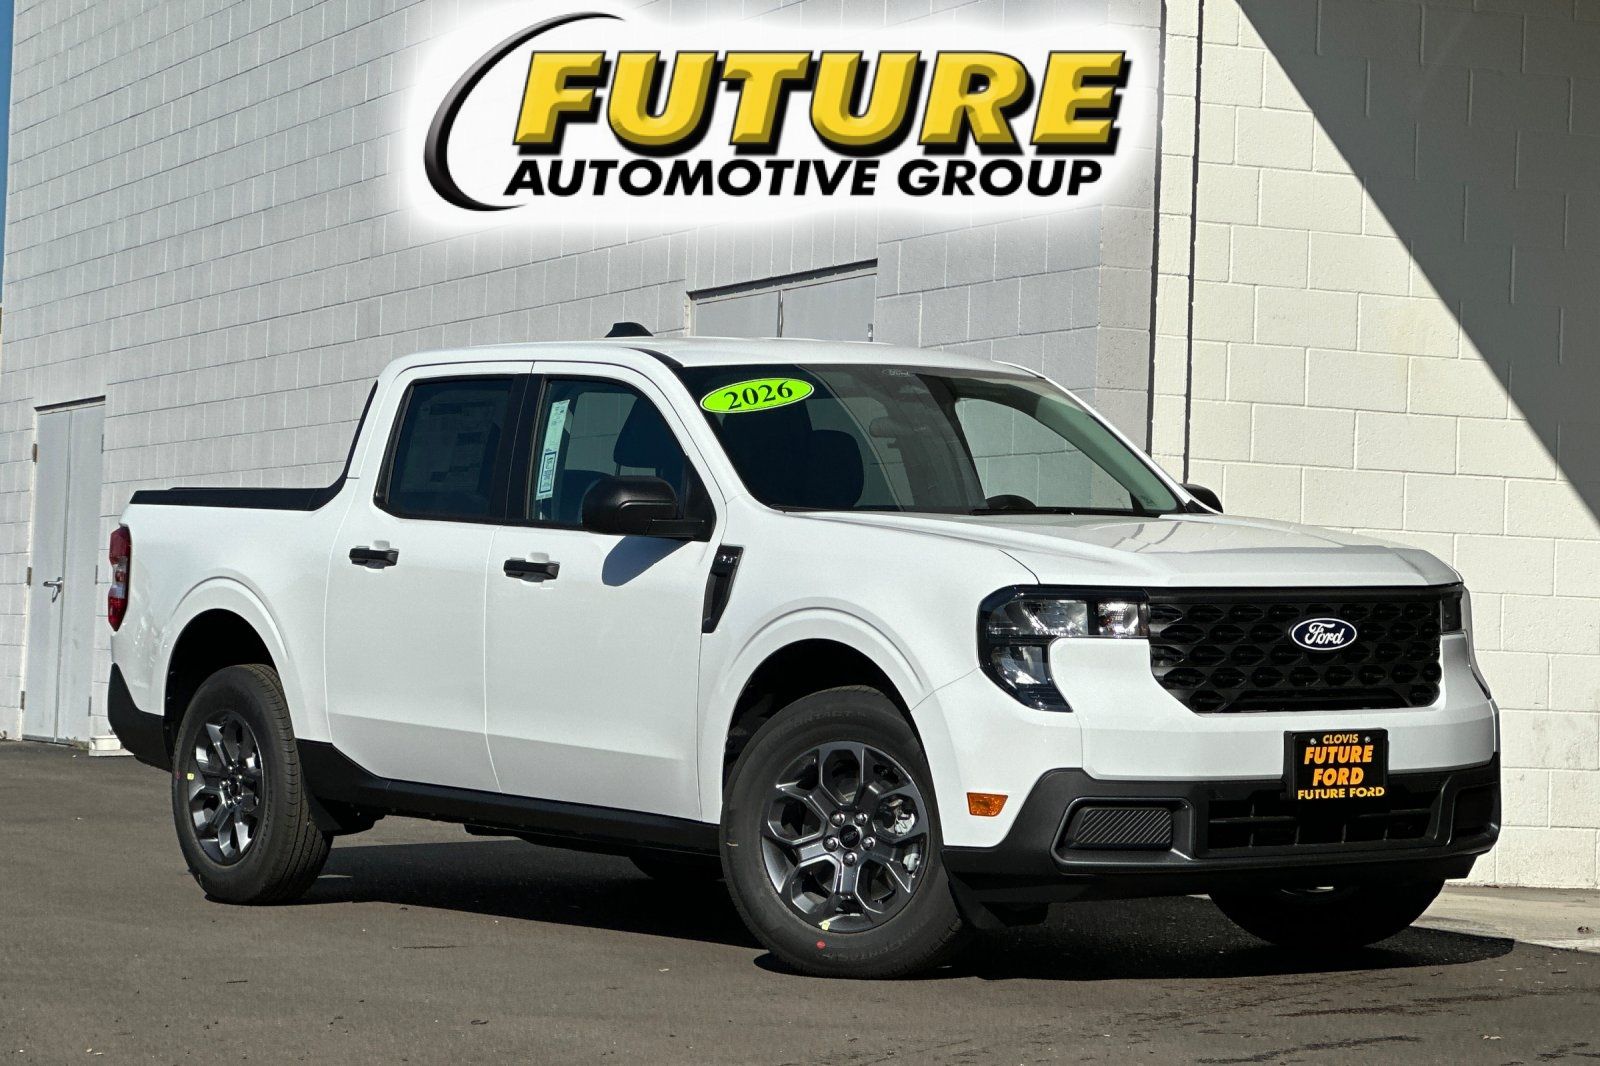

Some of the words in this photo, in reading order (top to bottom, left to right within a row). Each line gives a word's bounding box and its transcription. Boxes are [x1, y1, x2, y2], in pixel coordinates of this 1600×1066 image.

[724, 380, 794, 411] 2026
[1304, 622, 1346, 645] Ford
[1322, 733, 1359, 745] CLOVIS
[1303, 744, 1374, 765] FUTURE
[1312, 766, 1365, 787] FORD
[1297, 788, 1346, 800] FUTURE
[1349, 786, 1385, 798] FORD
